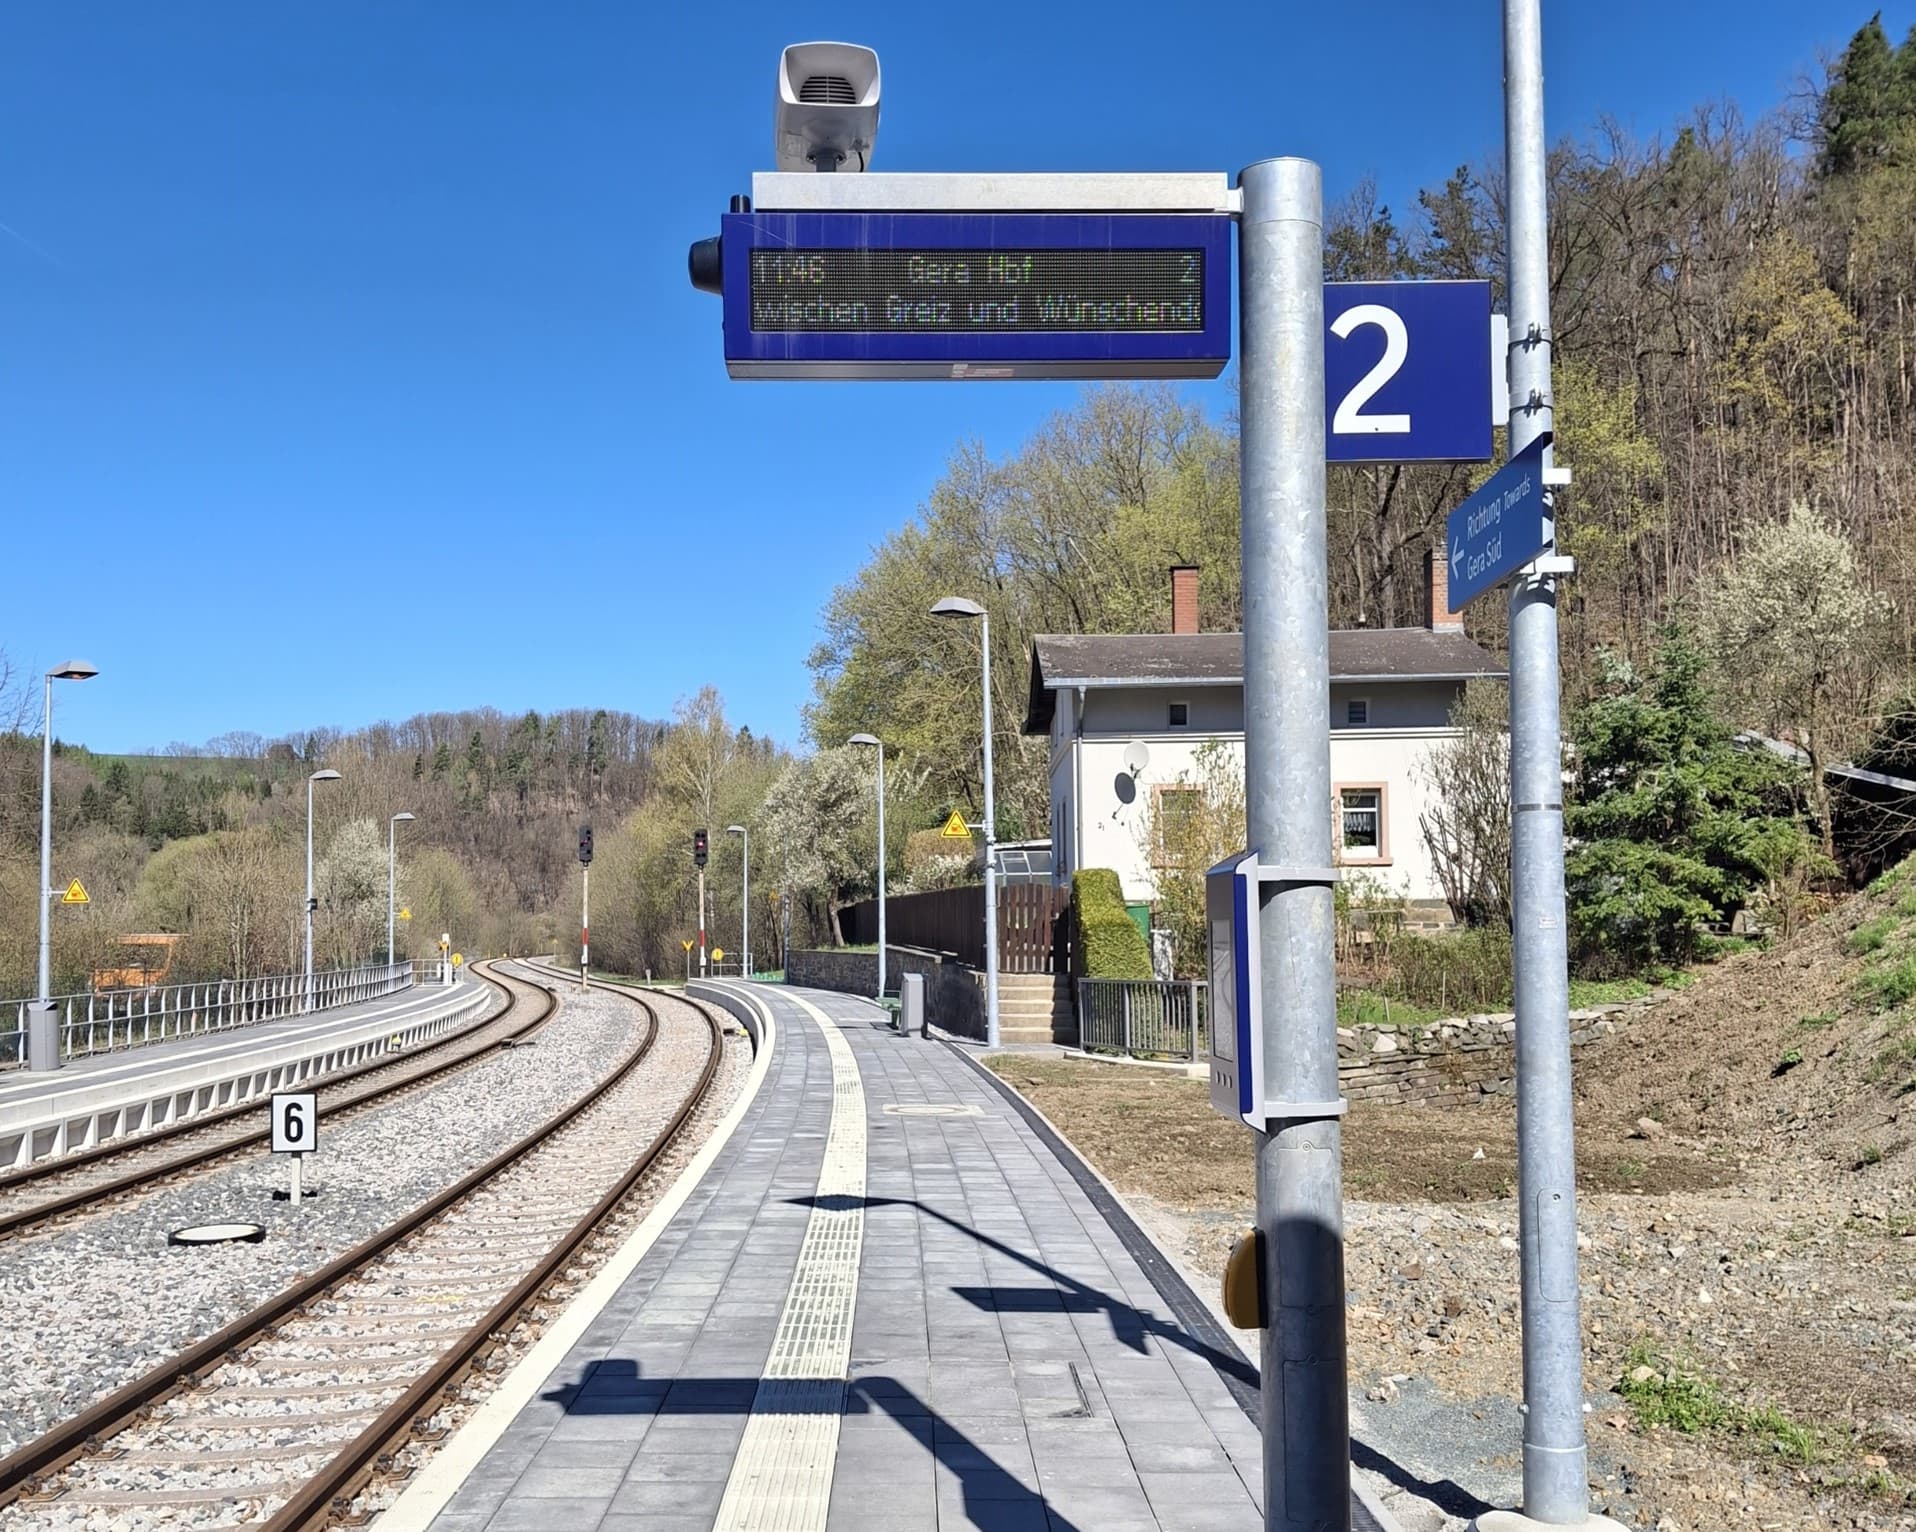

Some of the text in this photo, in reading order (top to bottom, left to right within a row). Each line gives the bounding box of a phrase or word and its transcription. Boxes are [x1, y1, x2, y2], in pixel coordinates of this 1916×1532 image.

[756, 255, 1196, 283] 11:46 Gera Hbf 2
[755, 295, 868, 322] wischen
[887, 295, 951, 322] Greiz
[969, 295, 1019, 322] und
[1330, 304, 1411, 434] 2
[1468, 474, 1531, 539] Richtung Towards
[1467, 532, 1502, 580] Gera Süd
[284, 1101, 304, 1143] 6
